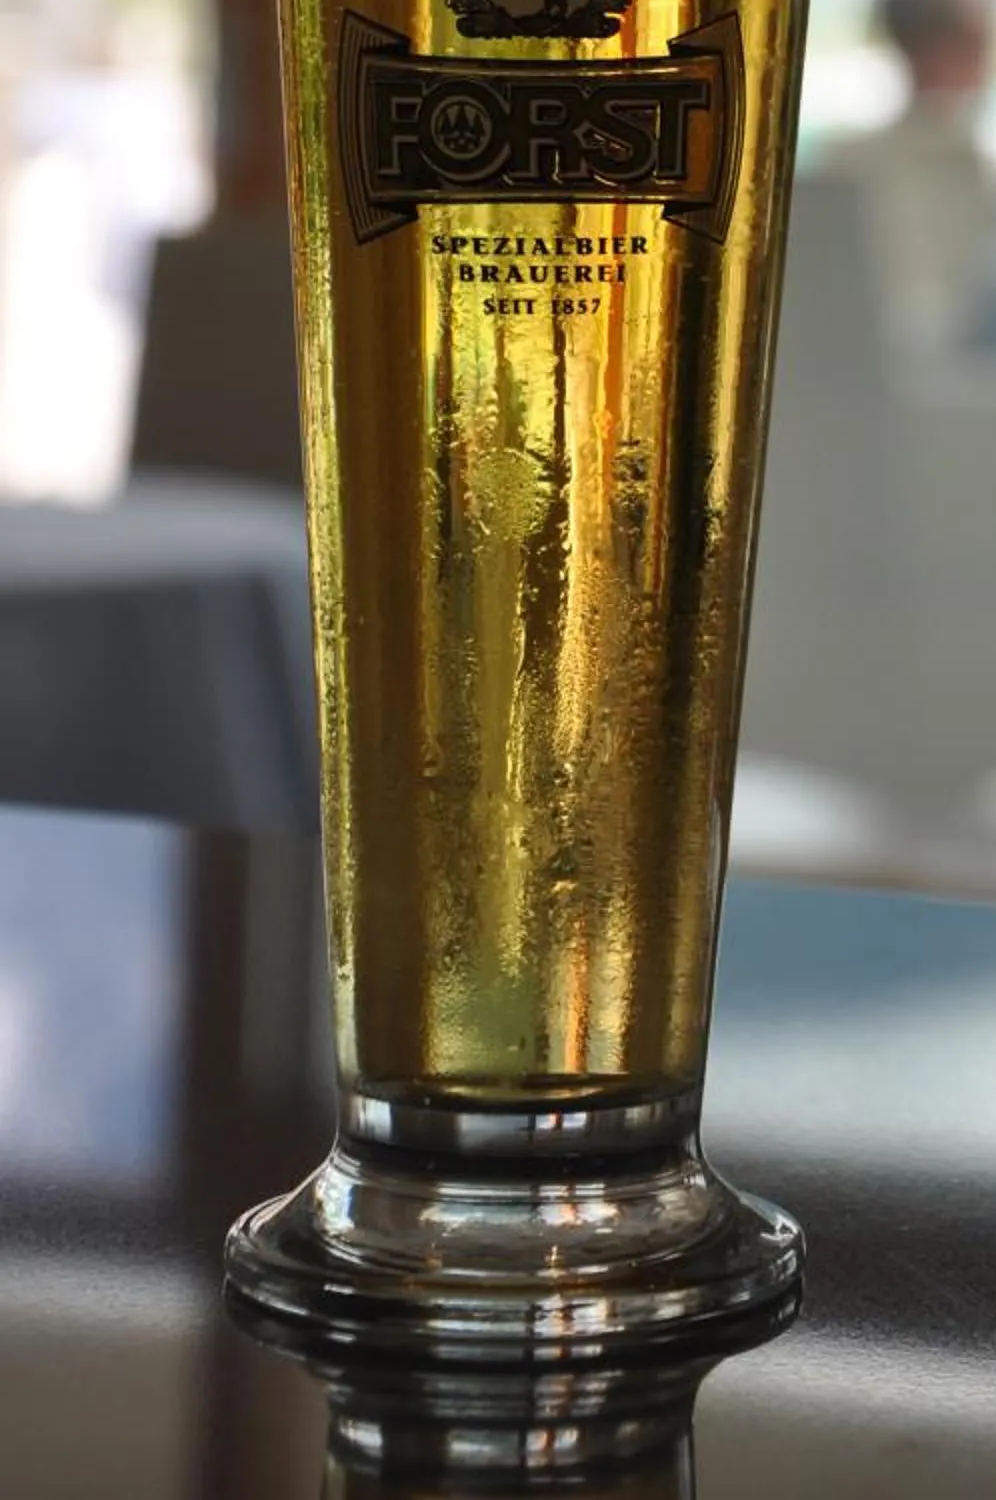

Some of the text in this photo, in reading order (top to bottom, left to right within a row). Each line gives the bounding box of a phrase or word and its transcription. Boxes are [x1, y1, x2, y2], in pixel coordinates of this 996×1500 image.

[373, 77, 709, 187] FORST
[432, 235, 649, 256] SPEZIALBIER
[459, 264, 626, 283] BRAUEREI
[483, 298, 601, 314] SEIT 1857
